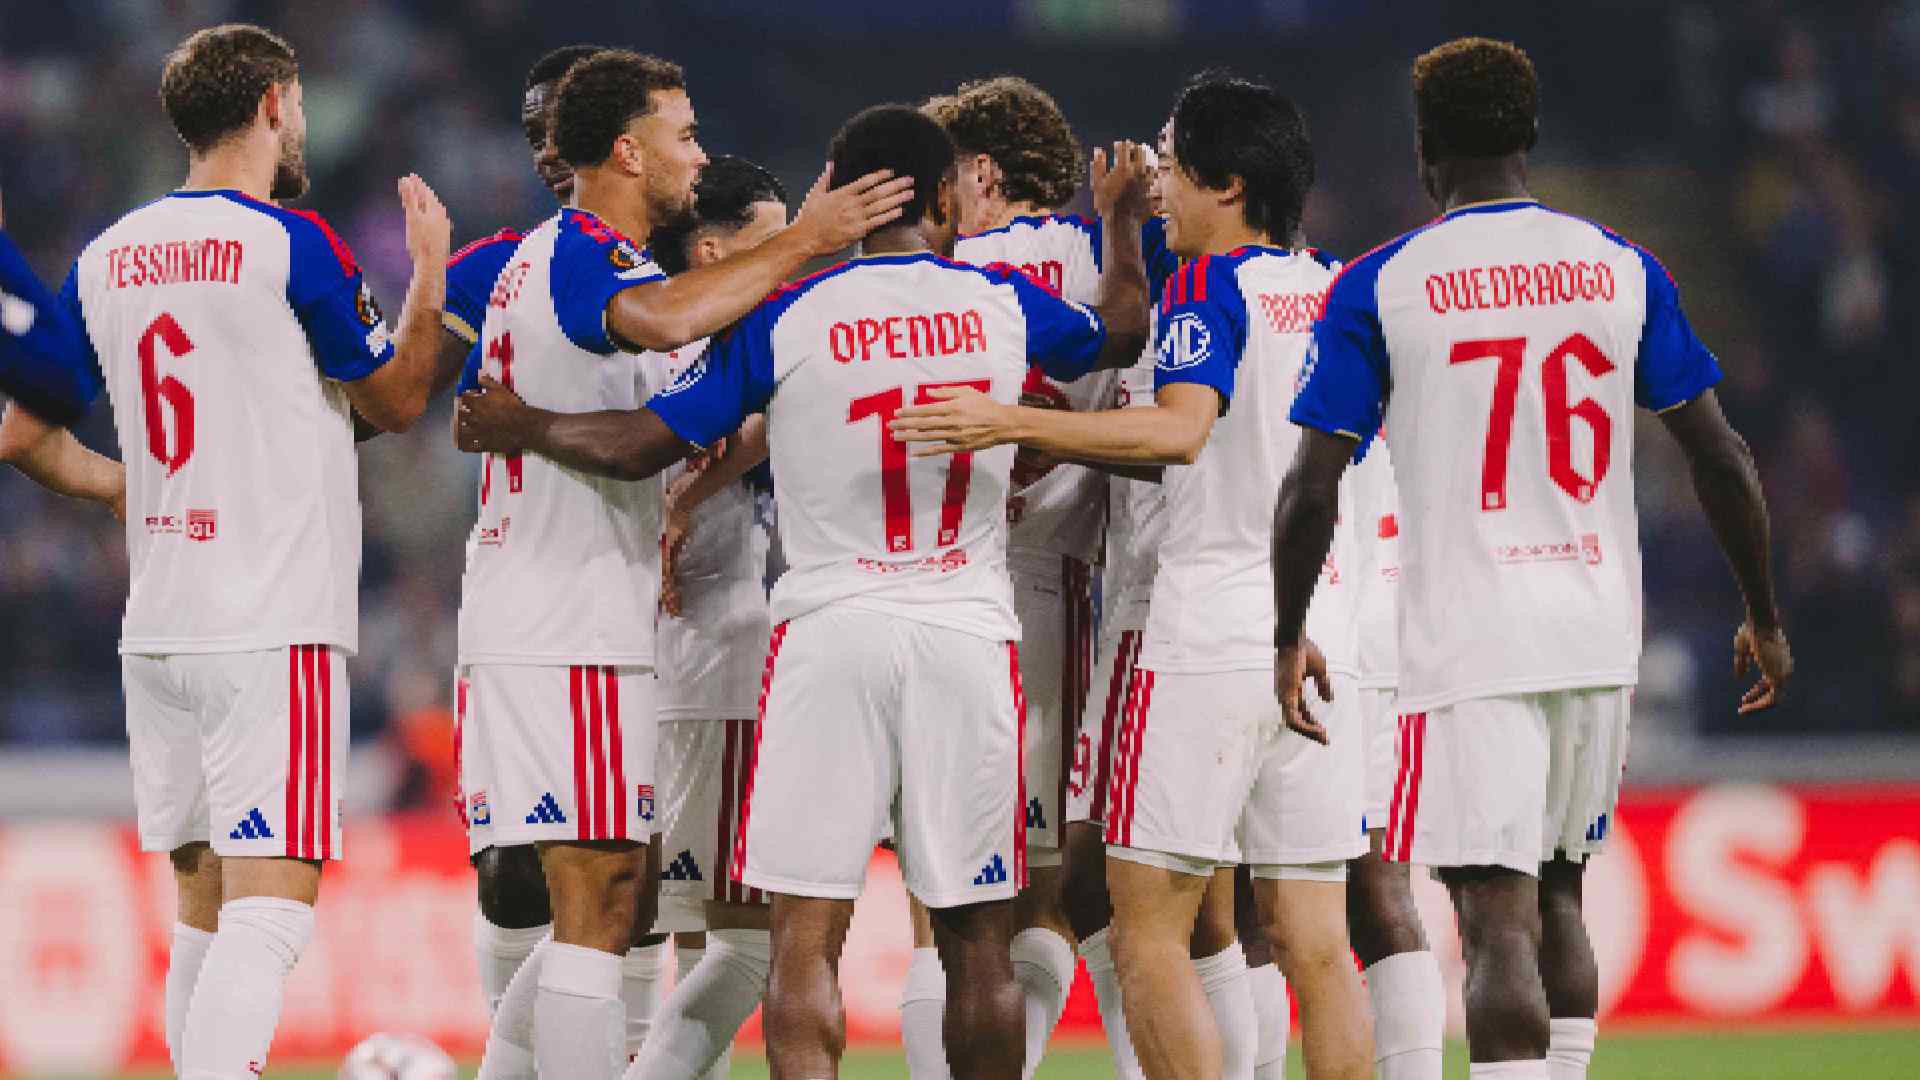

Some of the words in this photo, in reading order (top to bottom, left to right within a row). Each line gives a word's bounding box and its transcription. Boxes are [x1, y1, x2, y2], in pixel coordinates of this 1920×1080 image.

[829, 309, 987, 364] OPENDA
[1426, 261, 1615, 314] OUEDRAOGO
[137, 312, 194, 478] 6
[845, 379, 991, 552] 17
[1447, 333, 1616, 512] 76
